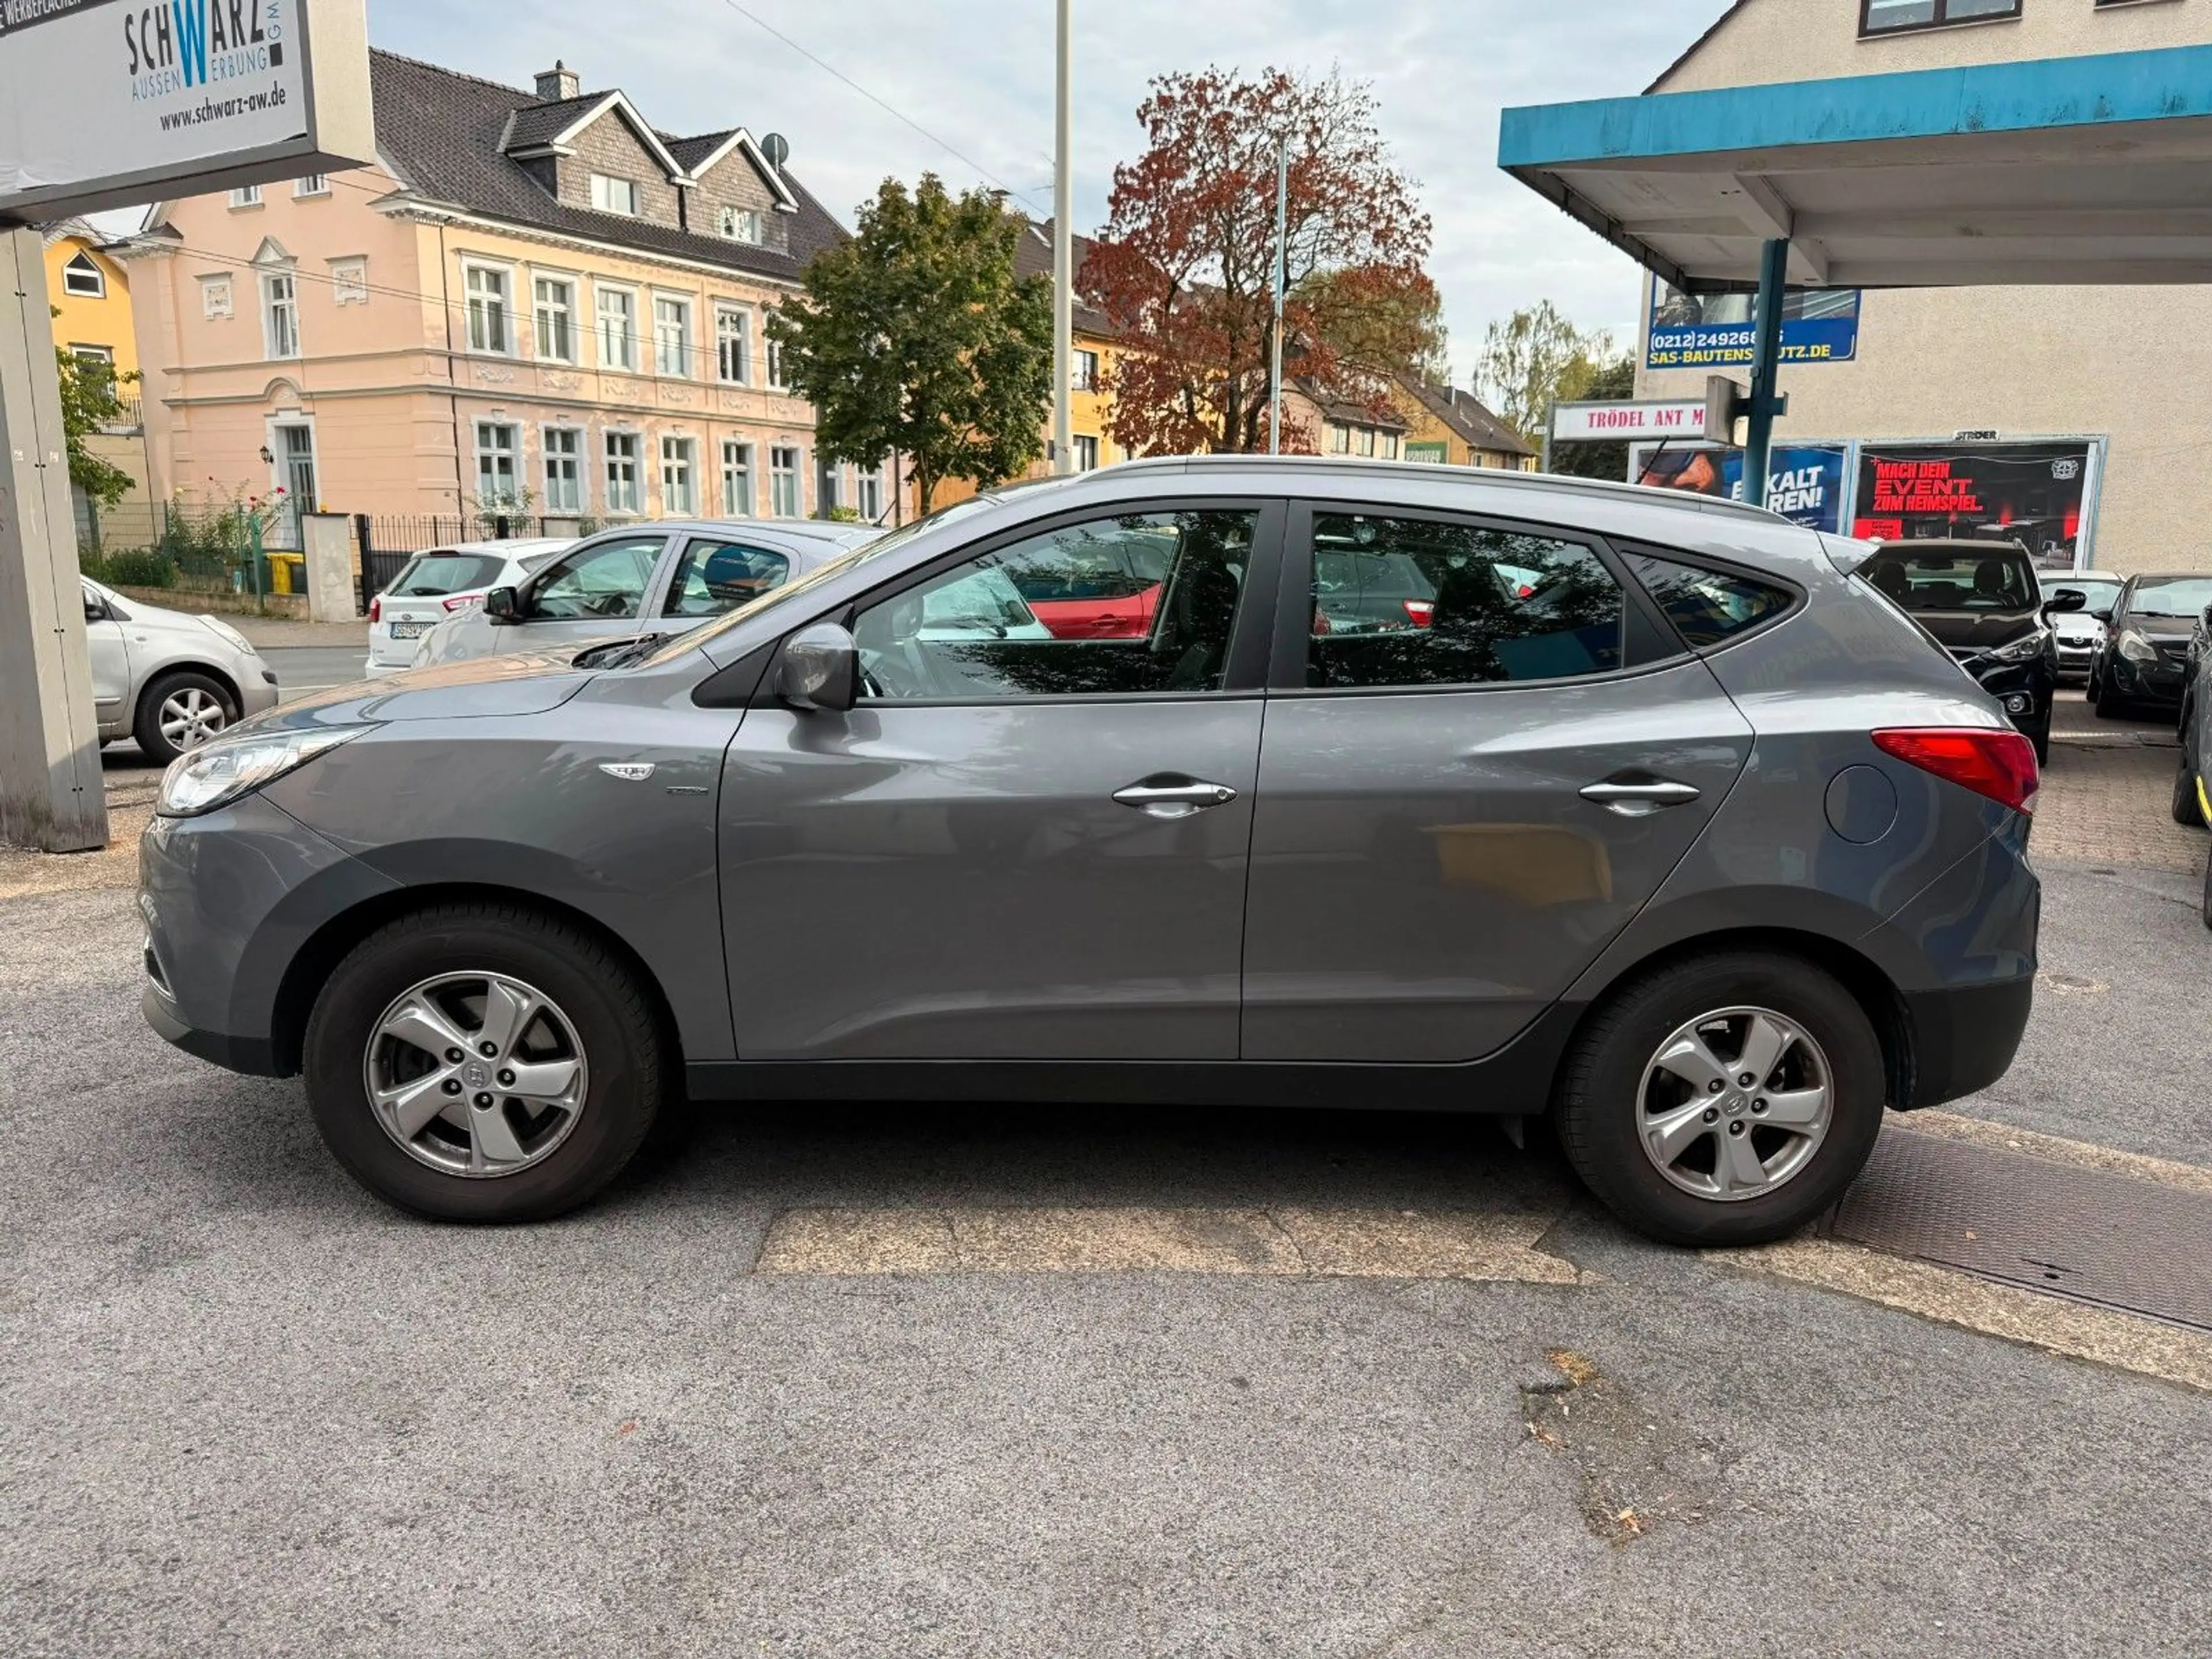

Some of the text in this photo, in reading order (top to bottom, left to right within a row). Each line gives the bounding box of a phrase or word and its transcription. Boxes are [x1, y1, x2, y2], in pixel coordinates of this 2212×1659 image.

[4, 0, 81, 25] WERBEFL
[124, 0, 264, 87] SCHWARZ
[160, 80, 286, 131] www.schwarz-aw.de
[1649, 345, 1831, 364] SAS-BAUTENSUTZ.DE
[1588, 408, 1645, 428] TRÖDEL
[1654, 410, 1683, 427] ANT
[1876, 461, 1950, 479] MACH DEIN
[1874, 479, 1972, 495] EVENT
[1873, 495, 1903, 511] ZUM
